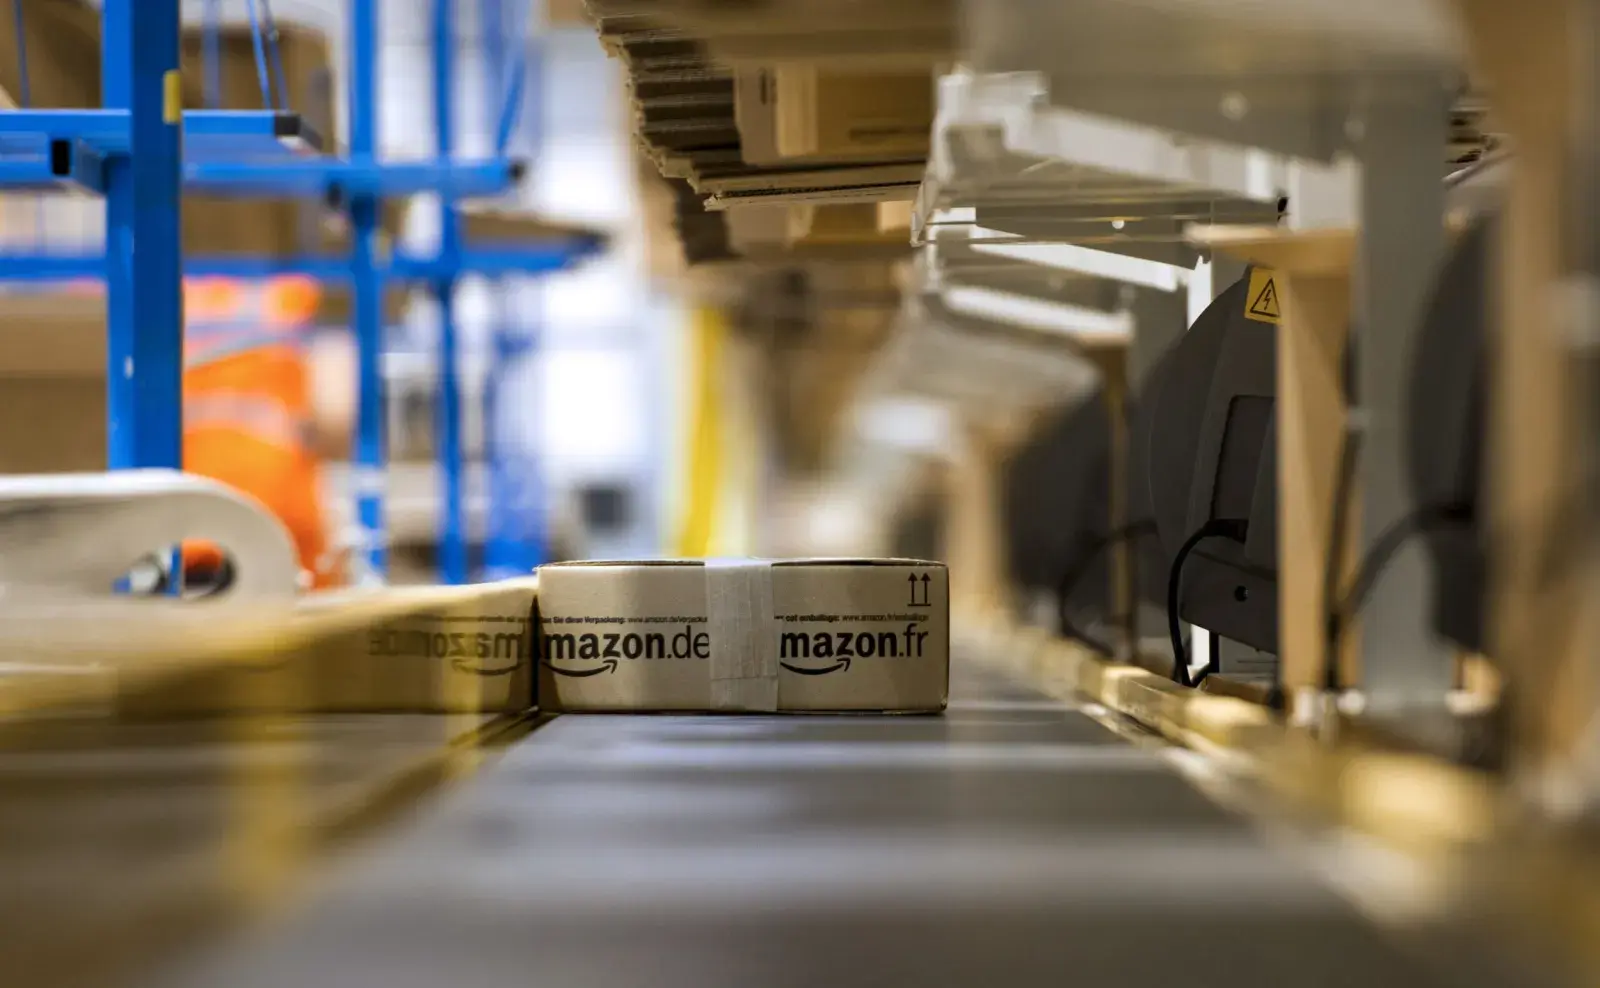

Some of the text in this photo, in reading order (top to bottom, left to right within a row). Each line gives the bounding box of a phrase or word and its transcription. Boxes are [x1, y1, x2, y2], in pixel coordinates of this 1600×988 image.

[628, 616, 708, 624] www.amazon.de/verpacku
[543, 625, 710, 659] mazon.de
[780, 623, 929, 658] mazon.fr
